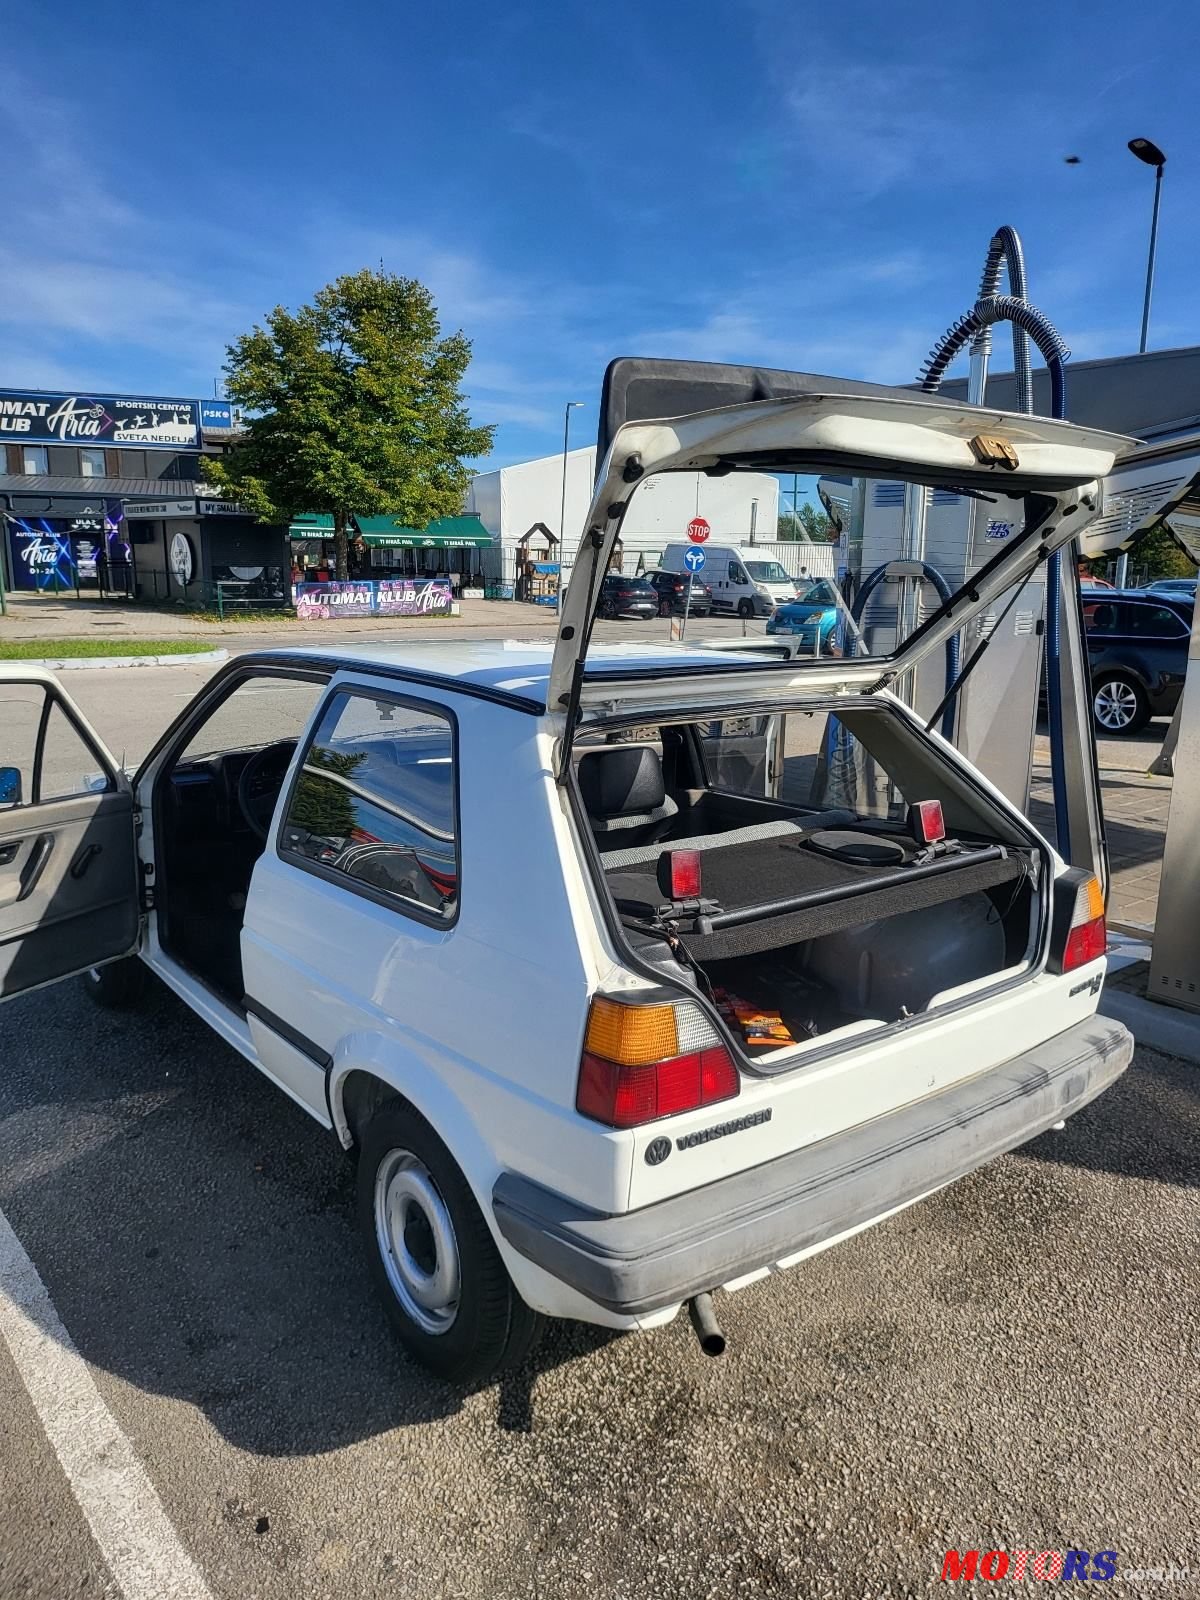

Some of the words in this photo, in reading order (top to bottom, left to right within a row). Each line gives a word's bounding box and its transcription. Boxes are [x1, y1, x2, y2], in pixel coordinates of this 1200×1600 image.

[0, 401, 51, 417] MAT
[115, 401, 156, 410] SPORTSKI
[157, 403, 192, 412] CENTAR
[203, 410, 222, 418] PSK
[47, 397, 101, 441] Aria
[117, 433, 148, 441] SVETA
[151, 435, 195, 444] NEDELJA
[688, 524, 710, 538] STOP
[298, 592, 374, 606] AUTOMAT
[376, 590, 416, 603] KLUB
[416, 581, 447, 613] Aria
[676, 1107, 773, 1151] VOLKSWAGEN
